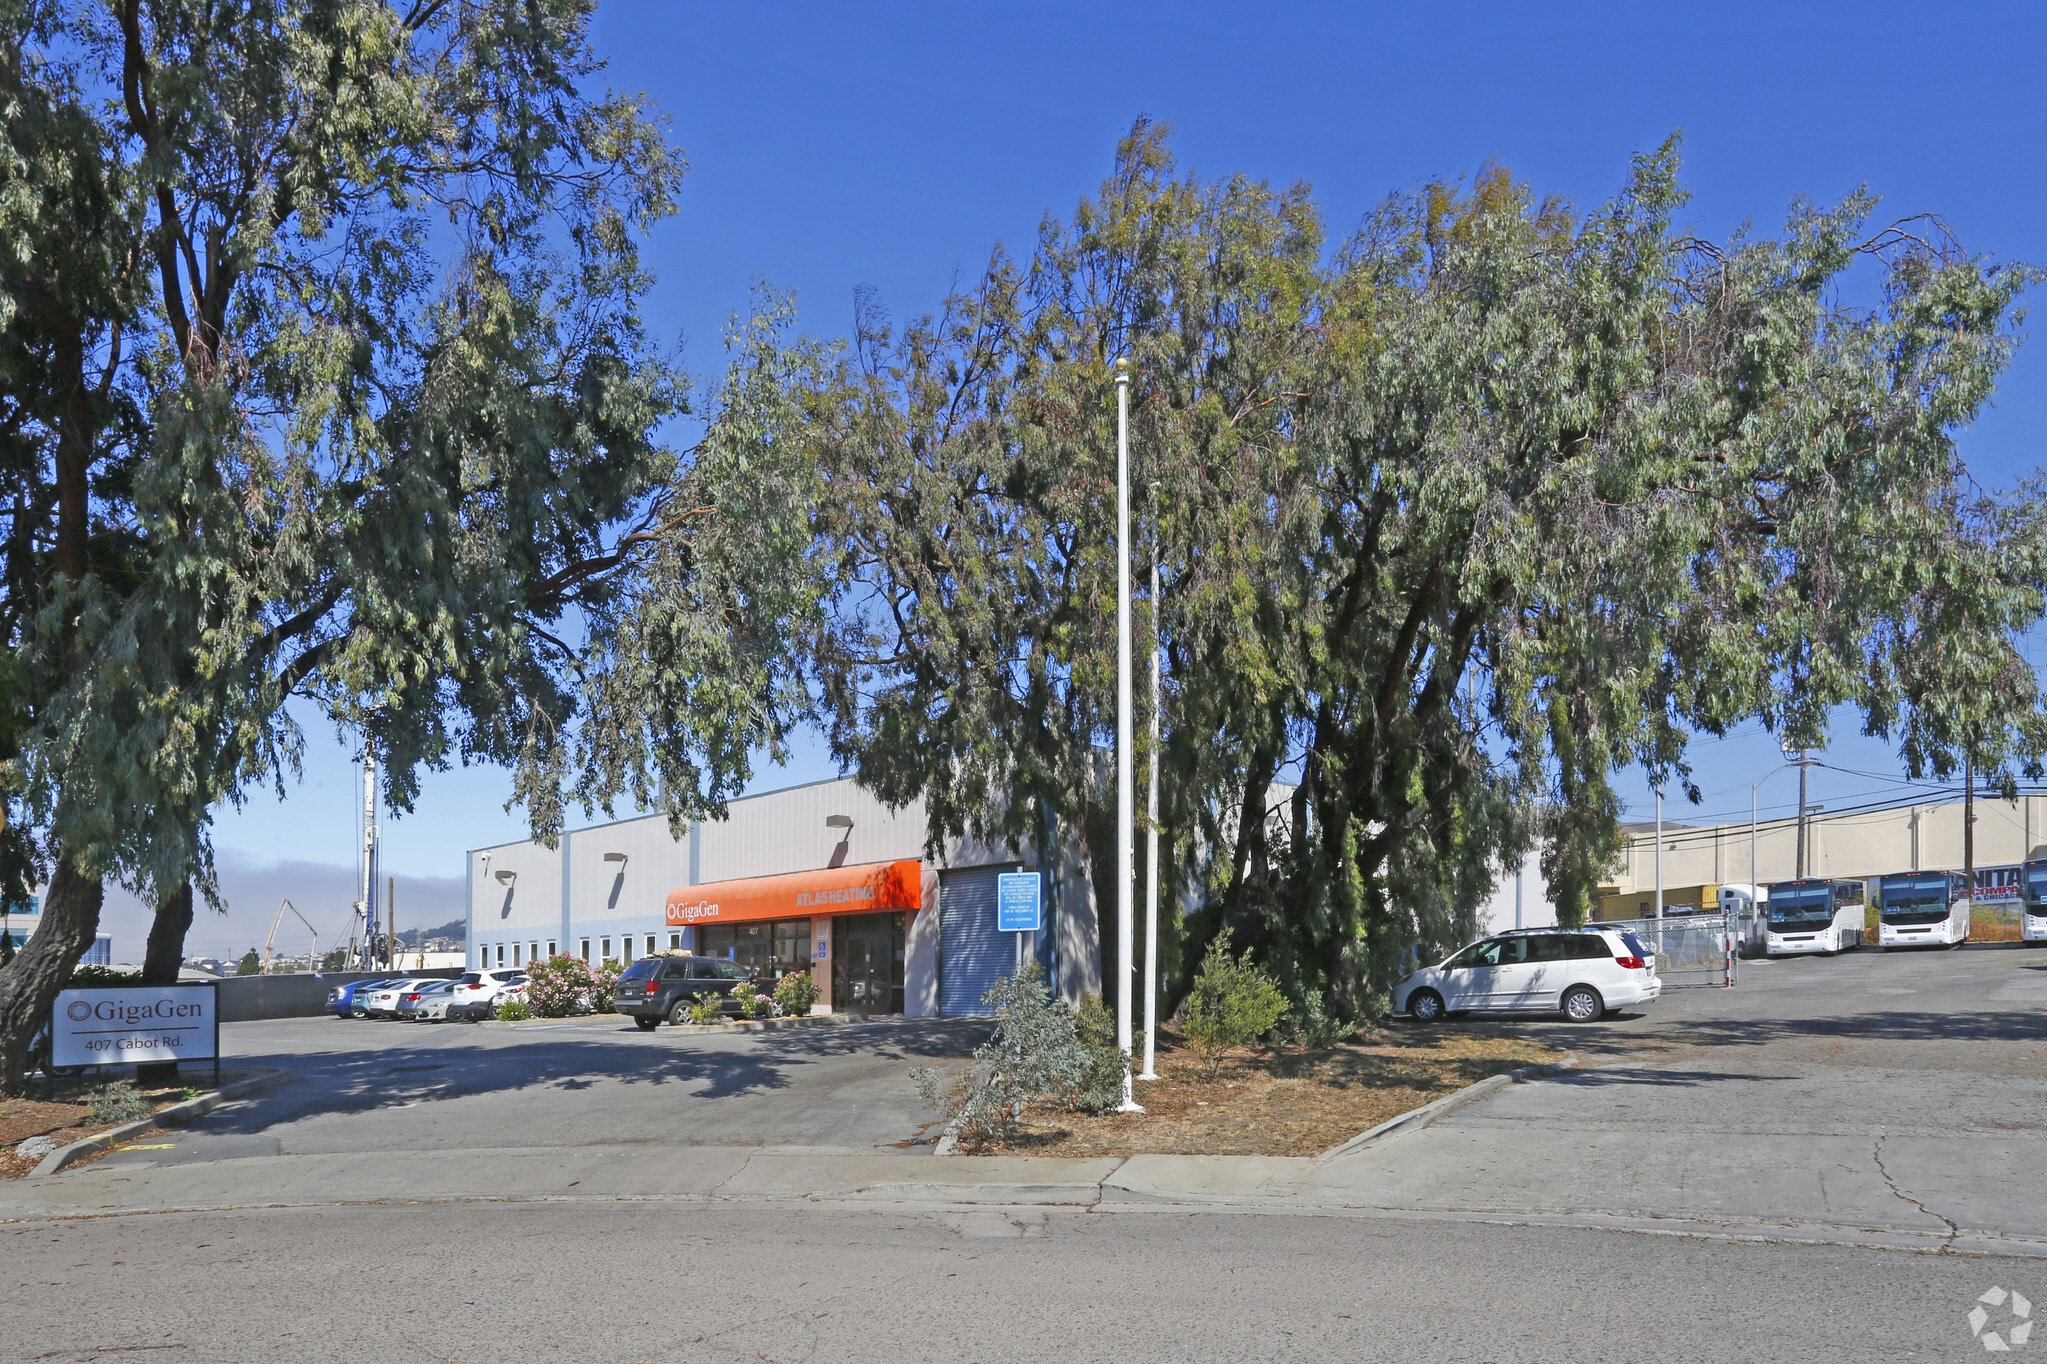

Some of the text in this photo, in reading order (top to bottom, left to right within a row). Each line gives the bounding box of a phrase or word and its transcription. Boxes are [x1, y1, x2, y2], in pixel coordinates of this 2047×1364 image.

[796, 885, 875, 907] ATLAS HEATING
[676, 900, 719, 922] GigaGen
[749, 927, 759, 935] 407
[94, 999, 203, 1025] GigaGen
[85, 1036, 184, 1052] 407 Cabot Rd.
